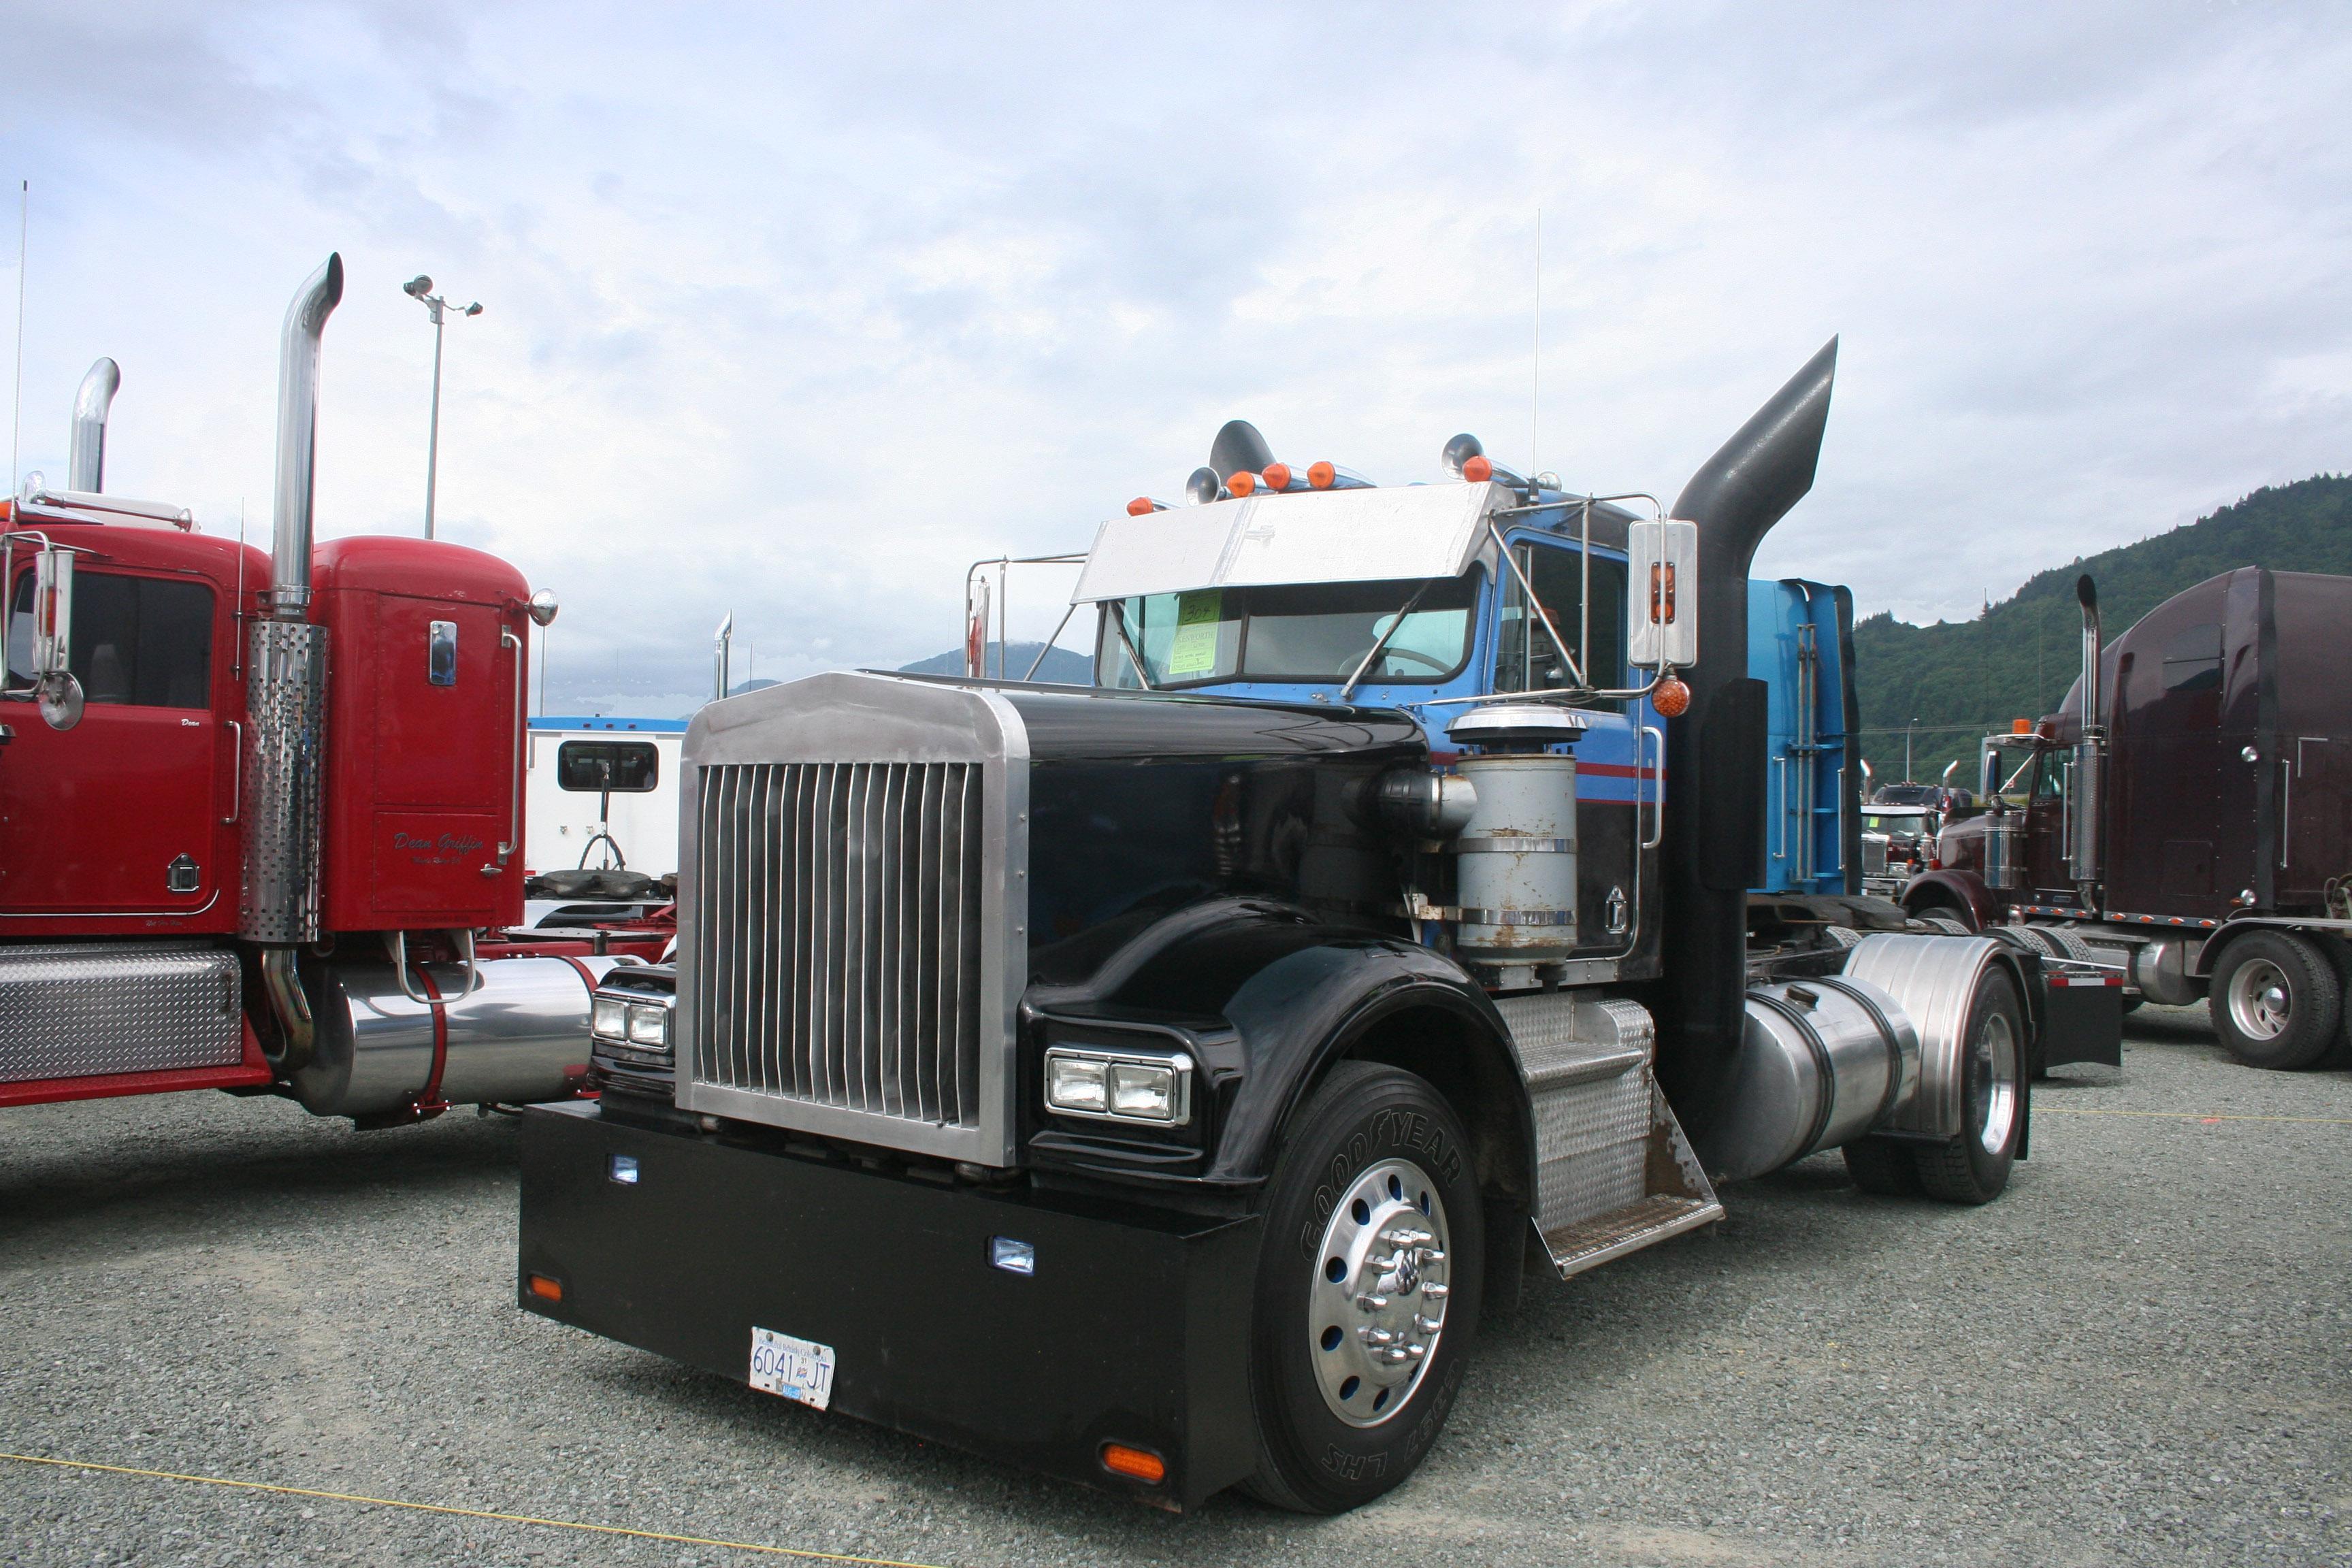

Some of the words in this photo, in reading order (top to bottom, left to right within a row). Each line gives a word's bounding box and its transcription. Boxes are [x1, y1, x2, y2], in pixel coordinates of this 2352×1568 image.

[1176, 631, 1214, 643] KENWORTH
[394, 832, 432, 849] Dean
[438, 832, 483, 855] Griffin
[1301, 1109, 1461, 1261] GOODYEAR
[753, 1345, 793, 1382] 6041
[806, 1362, 830, 1392] JT
[1320, 1443, 1388, 1482] LHS
